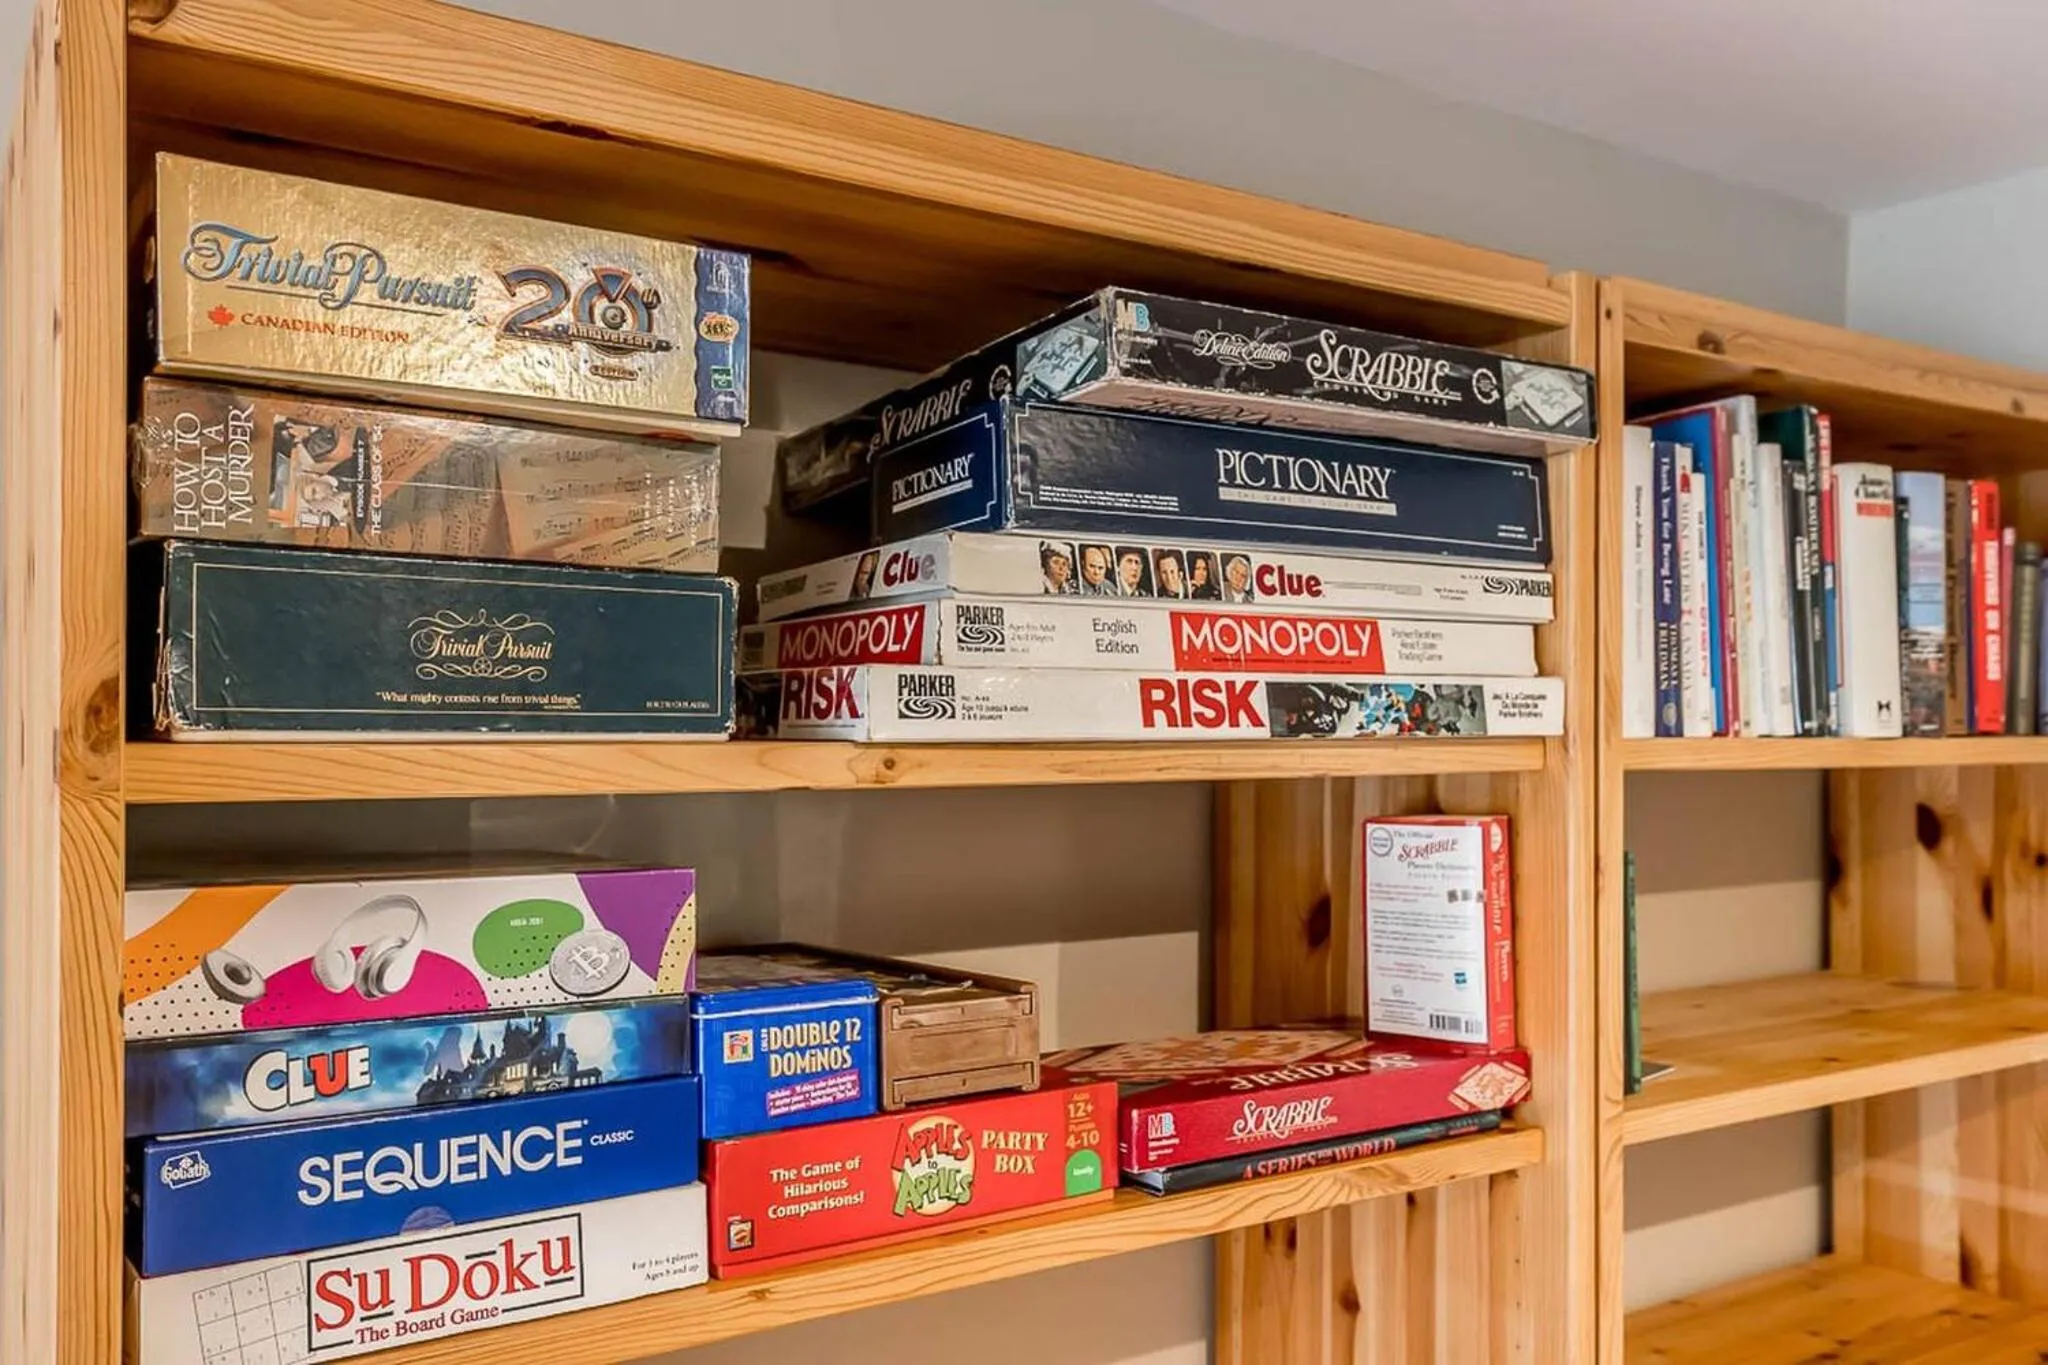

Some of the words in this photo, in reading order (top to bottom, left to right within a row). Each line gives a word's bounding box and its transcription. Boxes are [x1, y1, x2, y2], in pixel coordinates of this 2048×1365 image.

[181, 221, 338, 291] Trivial
[318, 241, 478, 310] Pursuit
[240, 312, 335, 336] CANADIAN
[339, 323, 410, 345] EDITION
[1243, 339, 1292, 363] Edition
[1306, 328, 1451, 401] SCRABBLE
[174, 411, 201, 449] TO
[201, 422, 225, 443] A
[227, 403, 256, 524] MURDER
[892, 453, 976, 501] PICTIONARY
[1215, 448, 1392, 499] PICTIONARY
[1660, 456, 1672, 493] Thank
[173, 459, 201, 534] HOW
[200, 446, 228, 529] HOST
[370, 464, 384, 507] CLASS
[370, 508, 383, 537] THE
[1660, 496, 1672, 518] You
[1660, 521, 1672, 541] for
[883, 550, 936, 588] Clue
[1658, 542, 1673, 577] Being
[1682, 549, 1693, 603] MYERS
[1255, 564, 1324, 598] Clue
[1659, 579, 1671, 605] Late
[956, 604, 1005, 626] PARKER
[1092, 617, 1138, 637] English
[410, 627, 485, 660] Trivial
[486, 629, 553, 661] Pursuit
[782, 611, 920, 663] MONOPOLY
[1095, 639, 1140, 655] Edition
[1180, 616, 1373, 658] MONOPOLY
[1658, 621, 1669, 690] FRIEDMAN
[1682, 620, 1693, 694] CANADA
[500, 693, 523, 704] from
[781, 667, 861, 721] RISK
[898, 674, 956, 697] PARKER
[1139, 678, 1267, 728] RISK
[844, 1017, 862, 1042] 12
[243, 1043, 373, 1112] CLUE
[1067, 1101, 1094, 1118] 12+
[1148, 1112, 1175, 1140] MB
[1232, 1096, 1336, 1139] SCRABBLE
[891, 1122, 973, 1173] APPLES
[981, 1129, 1049, 1152] PARTY
[1065, 1129, 1100, 1150] 4-10
[297, 1119, 584, 1206] SEQUENCE
[590, 1129, 635, 1147] CLASSIC
[769, 1168, 798, 1183] The
[801, 1161, 843, 1178] Game
[845, 1155, 862, 1170] of
[927, 1160, 938, 1169] to
[993, 1153, 1036, 1175] BOX
[767, 1190, 865, 1219] Comparisons!
[783, 1177, 849, 1199] Hilarious
[892, 1166, 974, 1218] APPLES
[314, 1267, 395, 1333] Su
[355, 1325, 390, 1346] The
[395, 1313, 446, 1338] Board
[449, 1303, 500, 1326] Game
